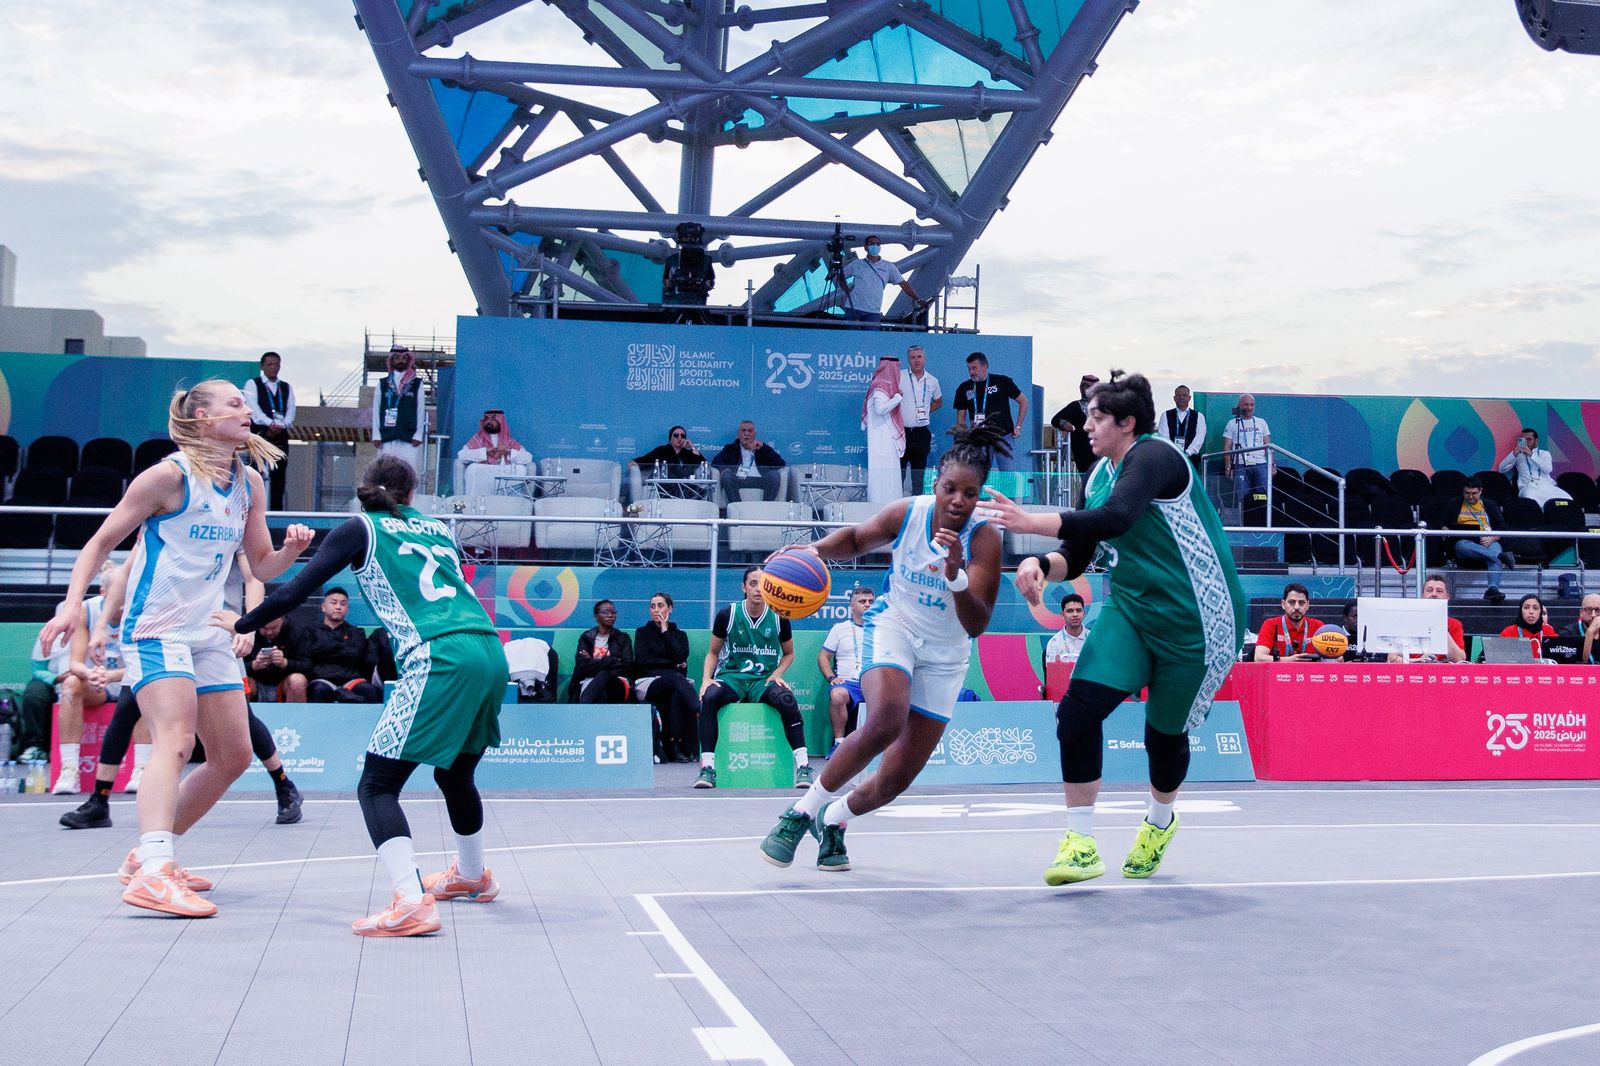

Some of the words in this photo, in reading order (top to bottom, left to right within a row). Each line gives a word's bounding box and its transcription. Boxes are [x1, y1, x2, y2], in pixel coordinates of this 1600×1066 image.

[680, 351, 715, 359] ISLAMIC
[680, 360, 734, 369] SOLIDARITY
[818, 352, 877, 369] RIYADH
[680, 369, 714, 377] SPORTS
[818, 371, 843, 380] 2025
[680, 378, 740, 387] ASSOCIATION
[763, 578, 804, 604] Wilson
[1321, 634, 1345, 643] Wilson
[732, 642, 752, 653] Saudi
[752, 644, 777, 656] Arabia
[1533, 711, 1586, 729] RIYADH
[1486, 711, 1529, 752] 25
[1533, 730, 1556, 740] 2025
[1556, 730, 1587, 742] الرياض
[484, 747, 537, 756] SULAIMAN
[540, 747, 552, 756] AL
[555, 747, 585, 755] HABIB
[728, 752, 749, 771] 25
